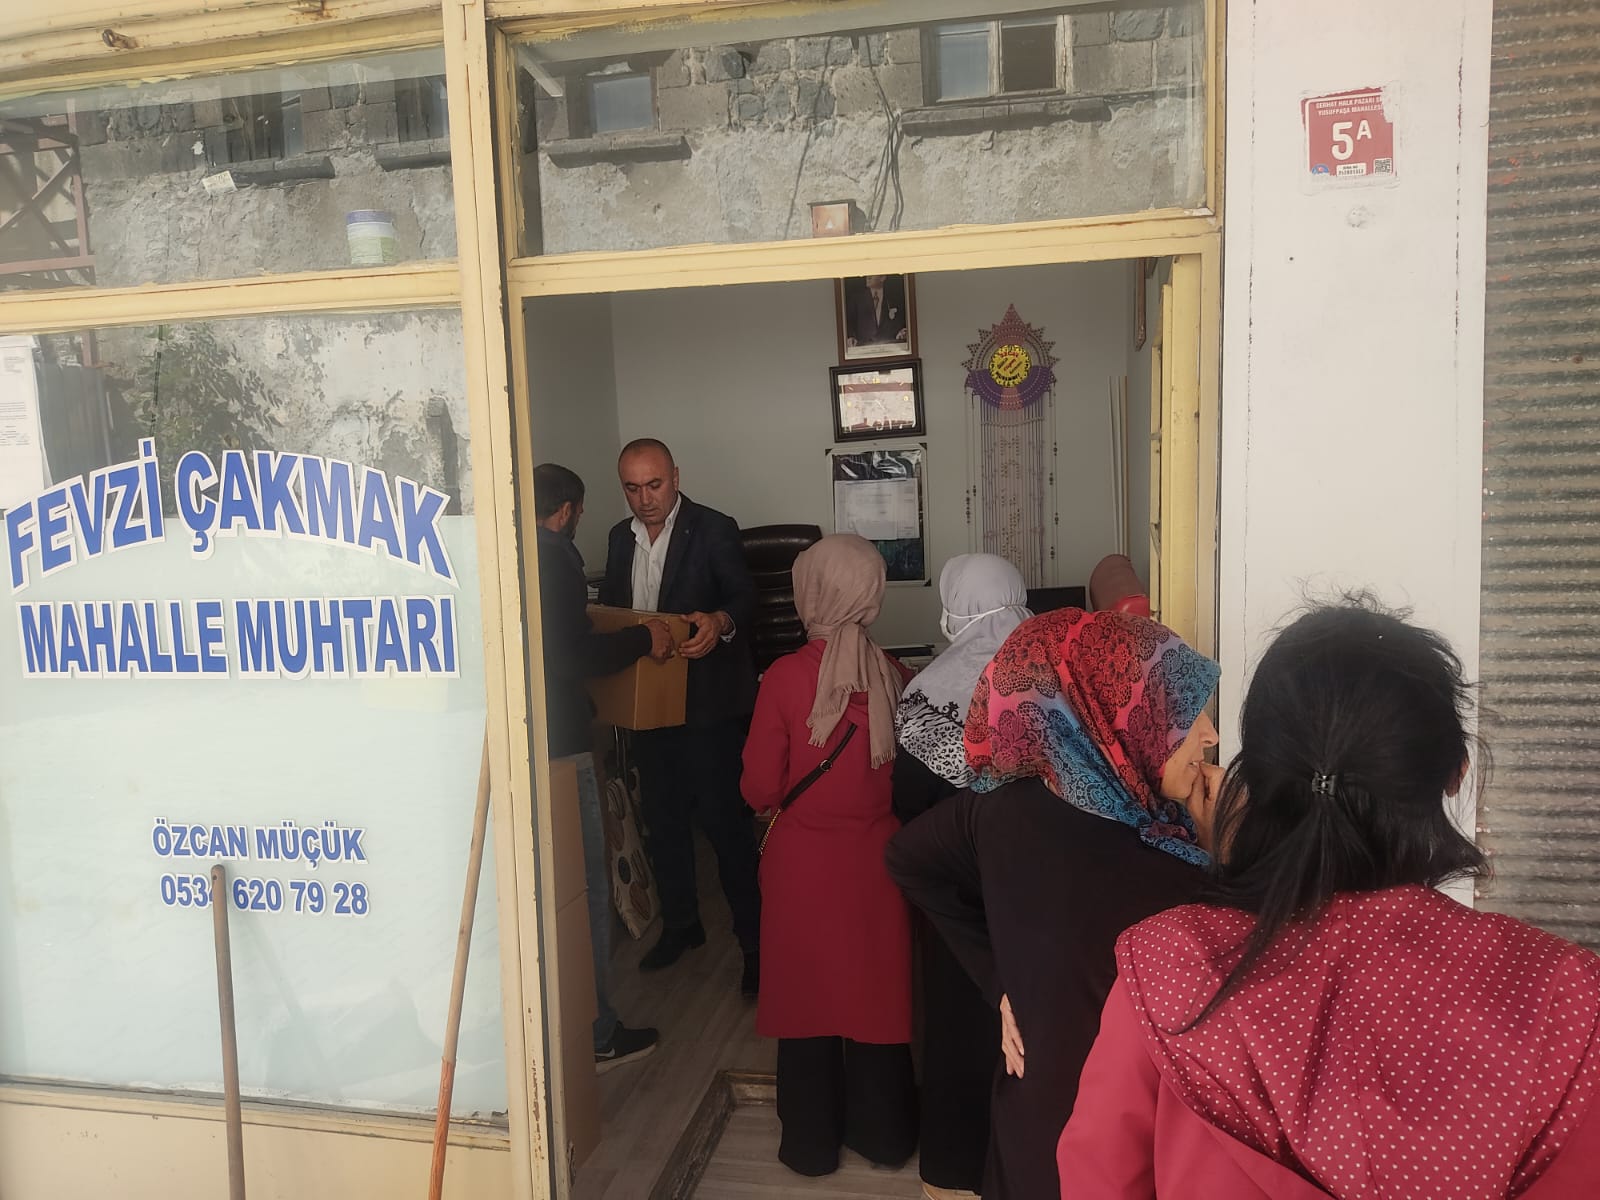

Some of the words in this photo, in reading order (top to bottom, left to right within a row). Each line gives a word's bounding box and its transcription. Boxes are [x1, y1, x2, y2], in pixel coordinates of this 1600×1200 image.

[1331, 121, 1354, 160] 5
[1356, 119, 1372, 140] A
[5, 439, 165, 591] FEVZİ
[177, 450, 455, 581] ÇAKMAK
[19, 600, 228, 673] MAHALLE
[235, 598, 456, 674] MUHTARI
[152, 817, 248, 857] ÖZCAN
[255, 820, 366, 868] MÜÇÜK
[233, 878, 282, 911] 620
[290, 881, 324, 913] 79
[333, 882, 367, 915] 28
